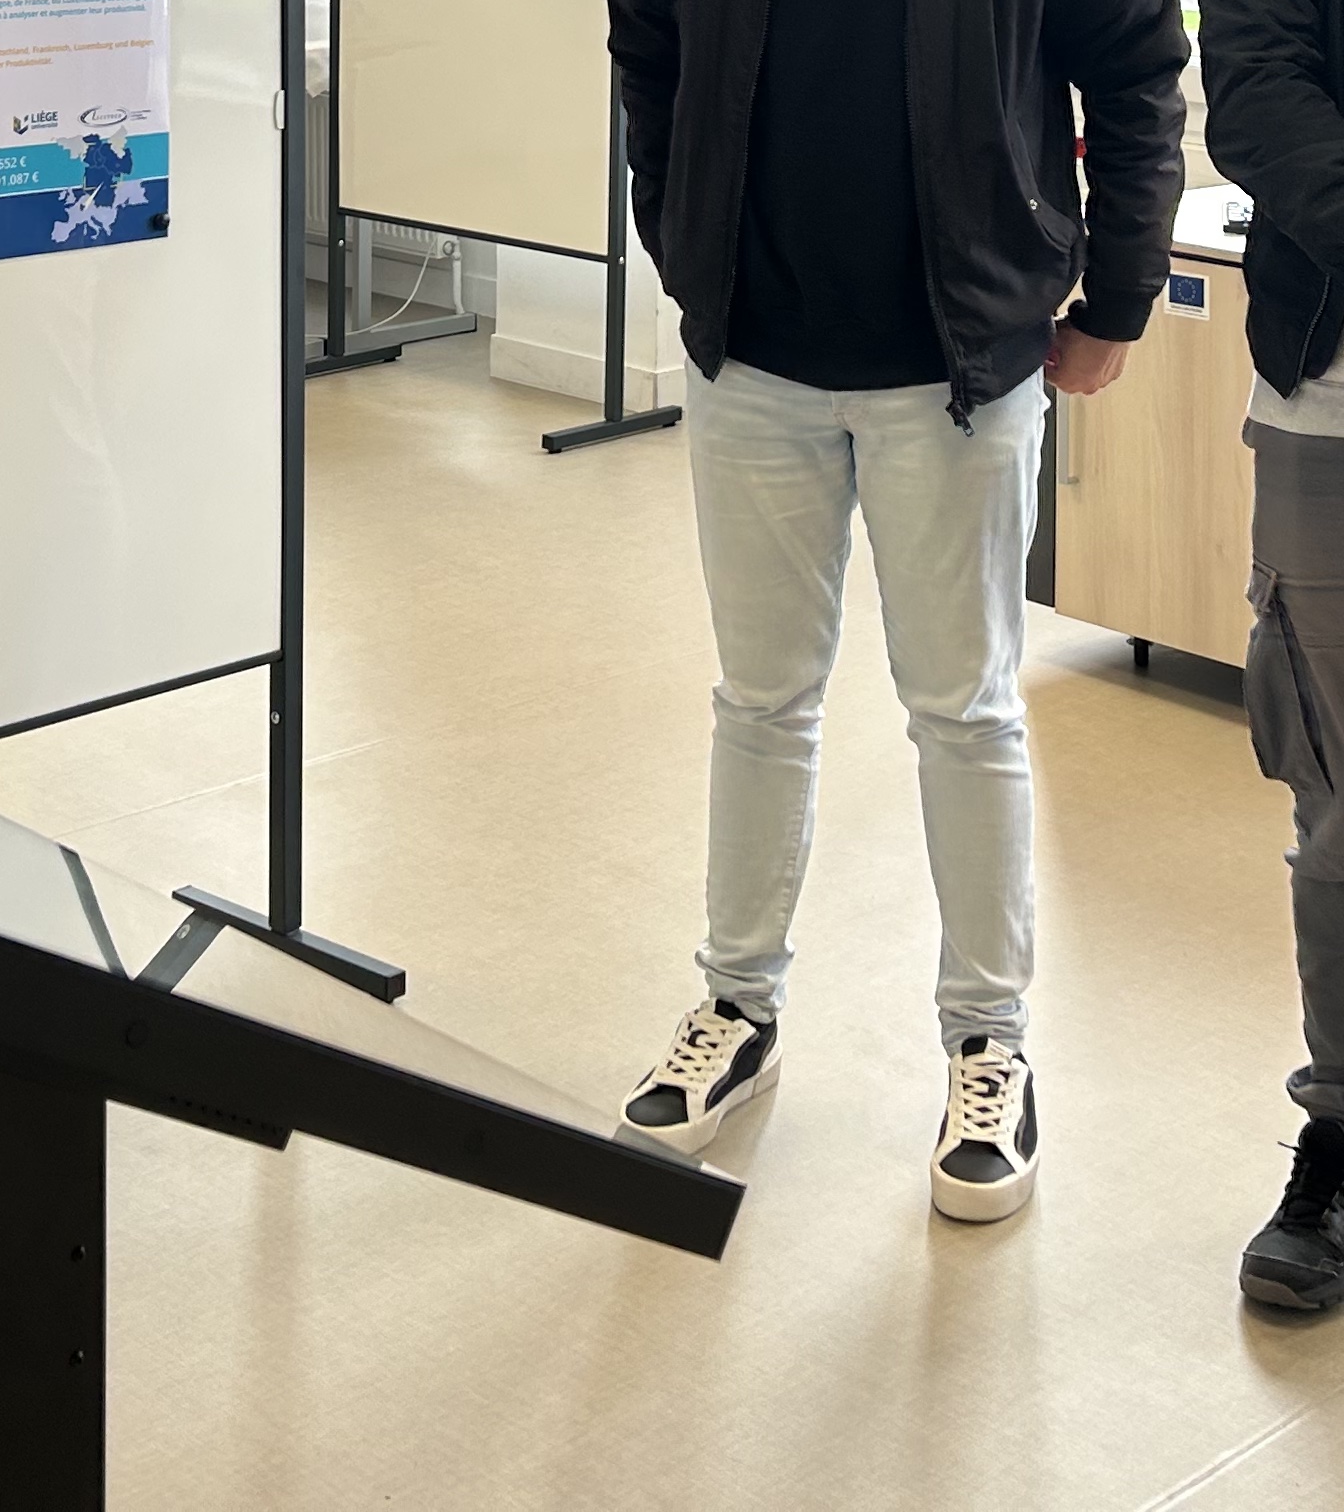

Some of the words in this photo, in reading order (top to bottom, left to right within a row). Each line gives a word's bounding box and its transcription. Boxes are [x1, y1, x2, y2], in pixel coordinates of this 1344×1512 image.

[9, 10, 38, 20] analyser
[40, 9, 48, 17] et
[19, 155, 27, 168] €
[32, 171, 40, 184] €
